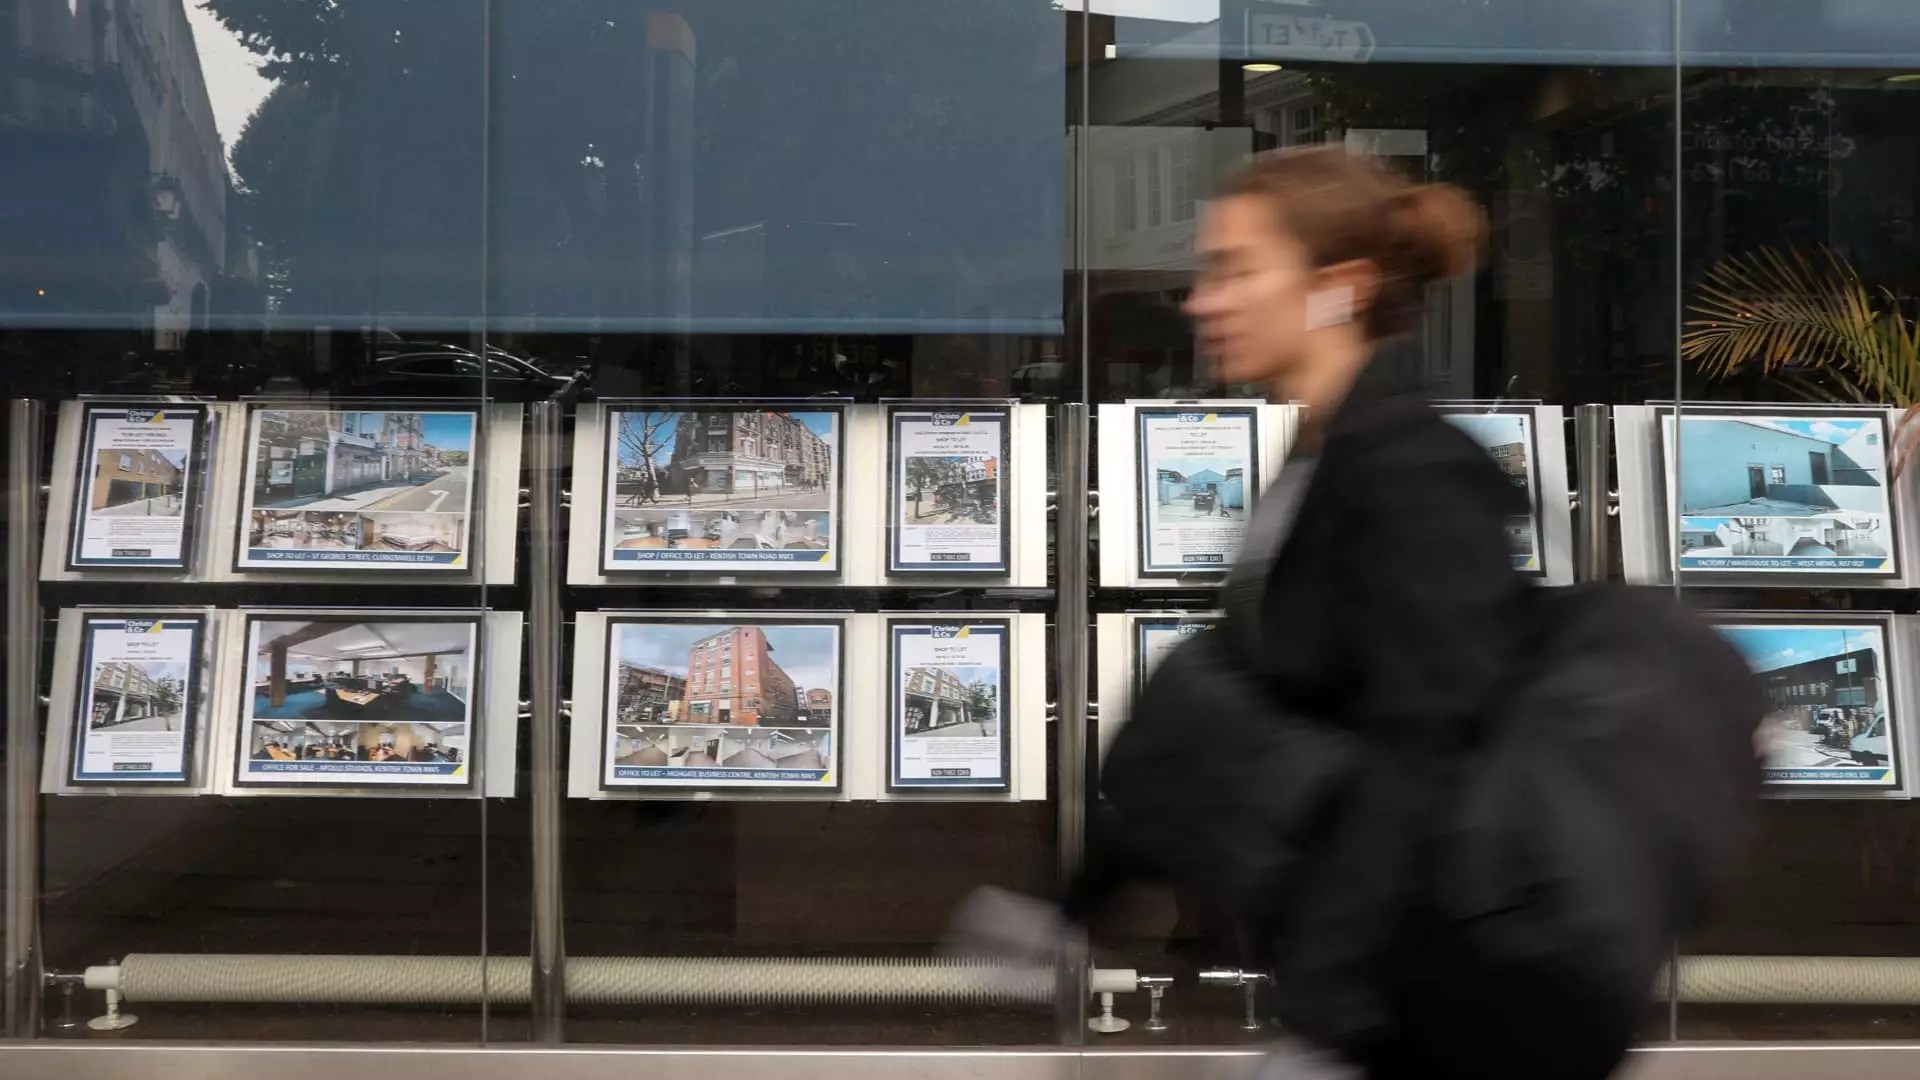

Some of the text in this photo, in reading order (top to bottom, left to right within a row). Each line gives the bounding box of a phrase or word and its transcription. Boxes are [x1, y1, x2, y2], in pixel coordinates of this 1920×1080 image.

[661, 552, 683, 560] OFFICE
[684, 552, 693, 560] TO
[693, 552, 704, 560] LET
